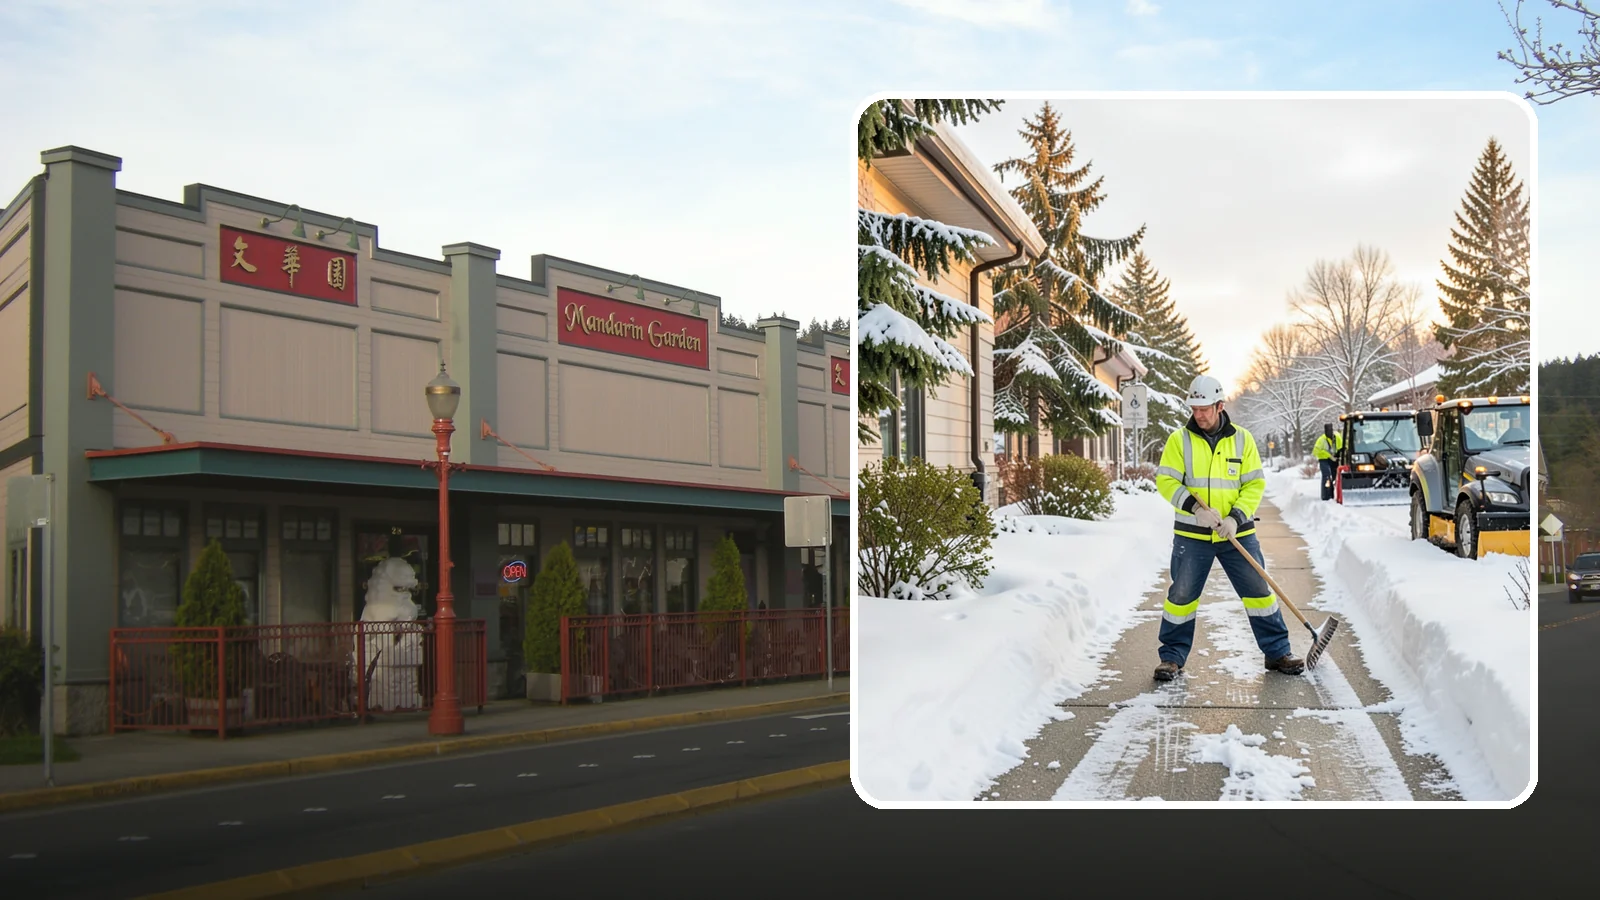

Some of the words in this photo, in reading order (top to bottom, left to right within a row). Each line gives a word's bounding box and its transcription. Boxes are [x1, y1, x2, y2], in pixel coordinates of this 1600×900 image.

[231, 235, 346, 291] 文華園
[564, 302, 644, 341] Mandarin
[648, 320, 701, 352] Garden
[503, 565, 527, 578] OPEN
